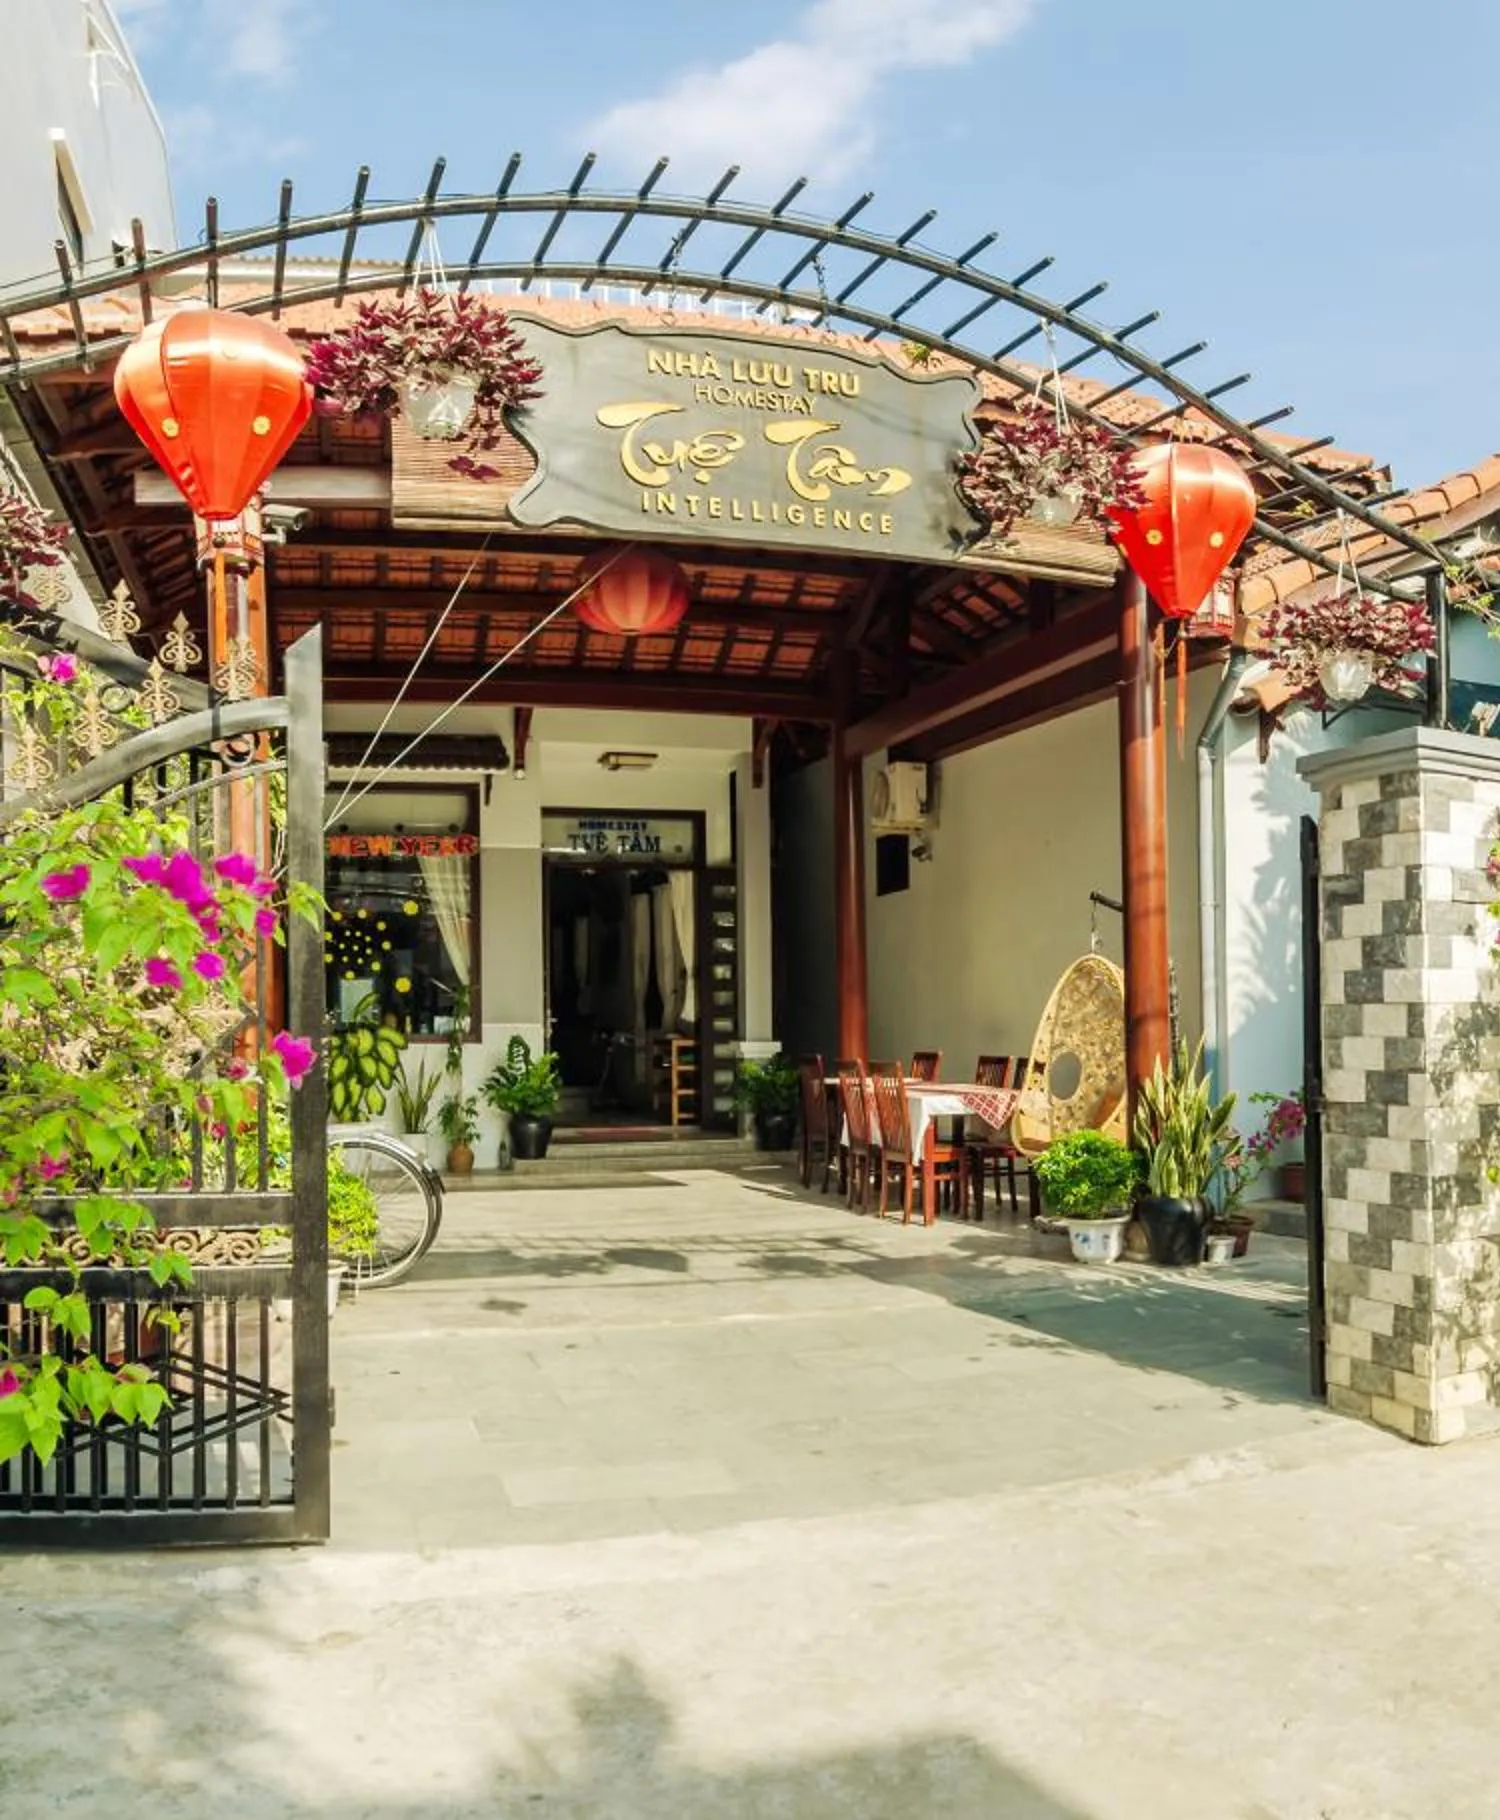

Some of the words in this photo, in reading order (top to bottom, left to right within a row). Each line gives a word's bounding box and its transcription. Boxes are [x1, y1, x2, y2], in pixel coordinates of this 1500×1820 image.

[647, 350, 722, 381] NHÀ
[694, 384, 817, 415] HOMESTAY
[640, 491, 893, 533] INTELLIGENCE
[399, 833, 479, 857] YEAR
